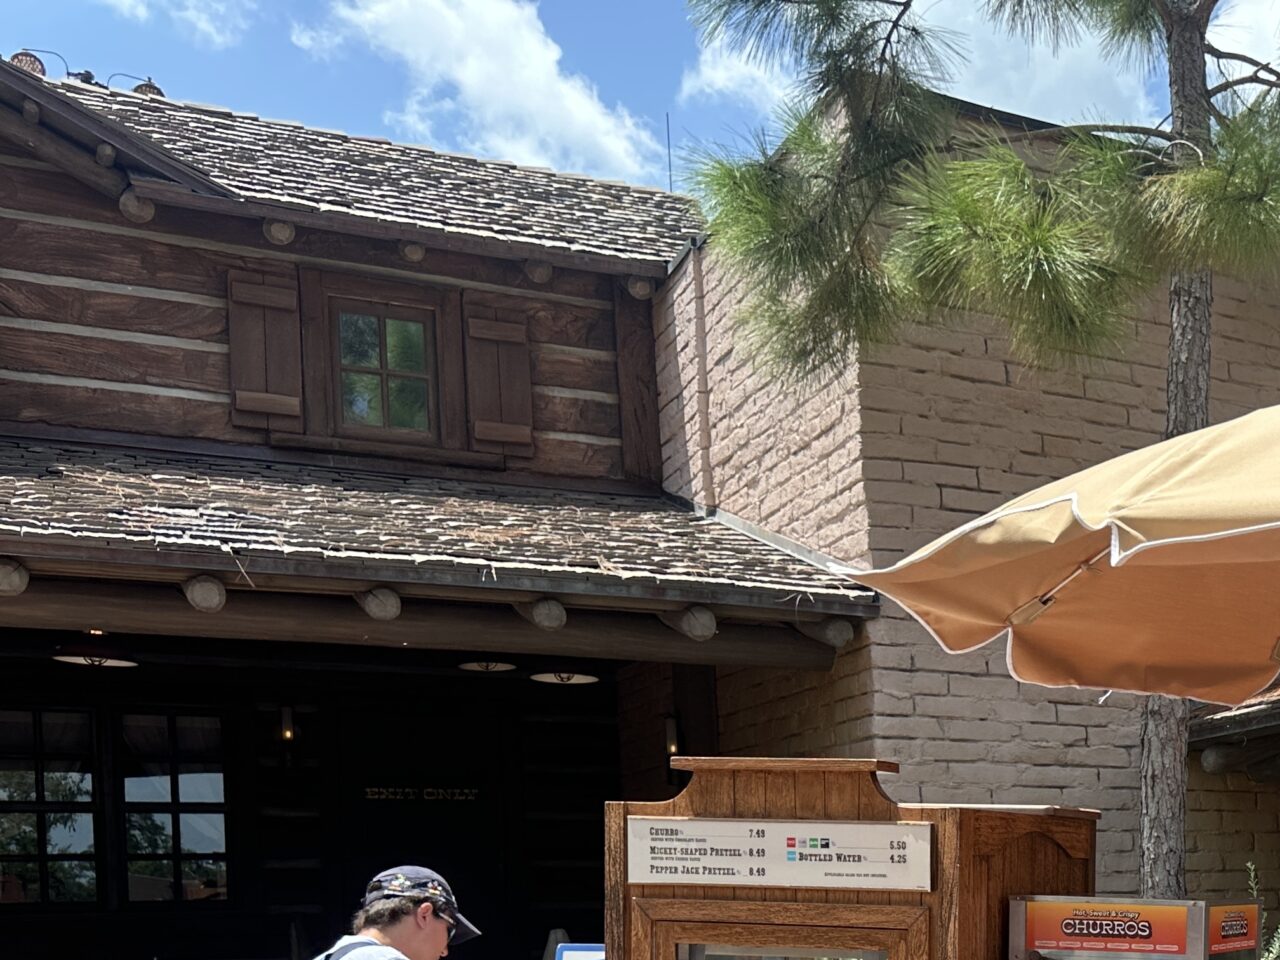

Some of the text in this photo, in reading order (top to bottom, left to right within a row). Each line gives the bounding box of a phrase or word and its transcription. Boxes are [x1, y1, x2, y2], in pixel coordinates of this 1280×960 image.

[364, 787, 479, 800] EXIT ONLY
[649, 826, 766, 839] CHURRO 7.49
[649, 845, 766, 858] MICKEY-SHAPED PRETZEL 8.49
[889, 840, 907, 850] 5.50
[798, 852, 833, 863] BOTTLED
[835, 853, 862, 863] WATER
[889, 854, 907, 864] 4.25
[649, 864, 766, 877] PEPPER JACK PRETZEL 8.49
[1118, 911, 1140, 920] Crispy
[1061, 918, 1151, 936] CHURROS
